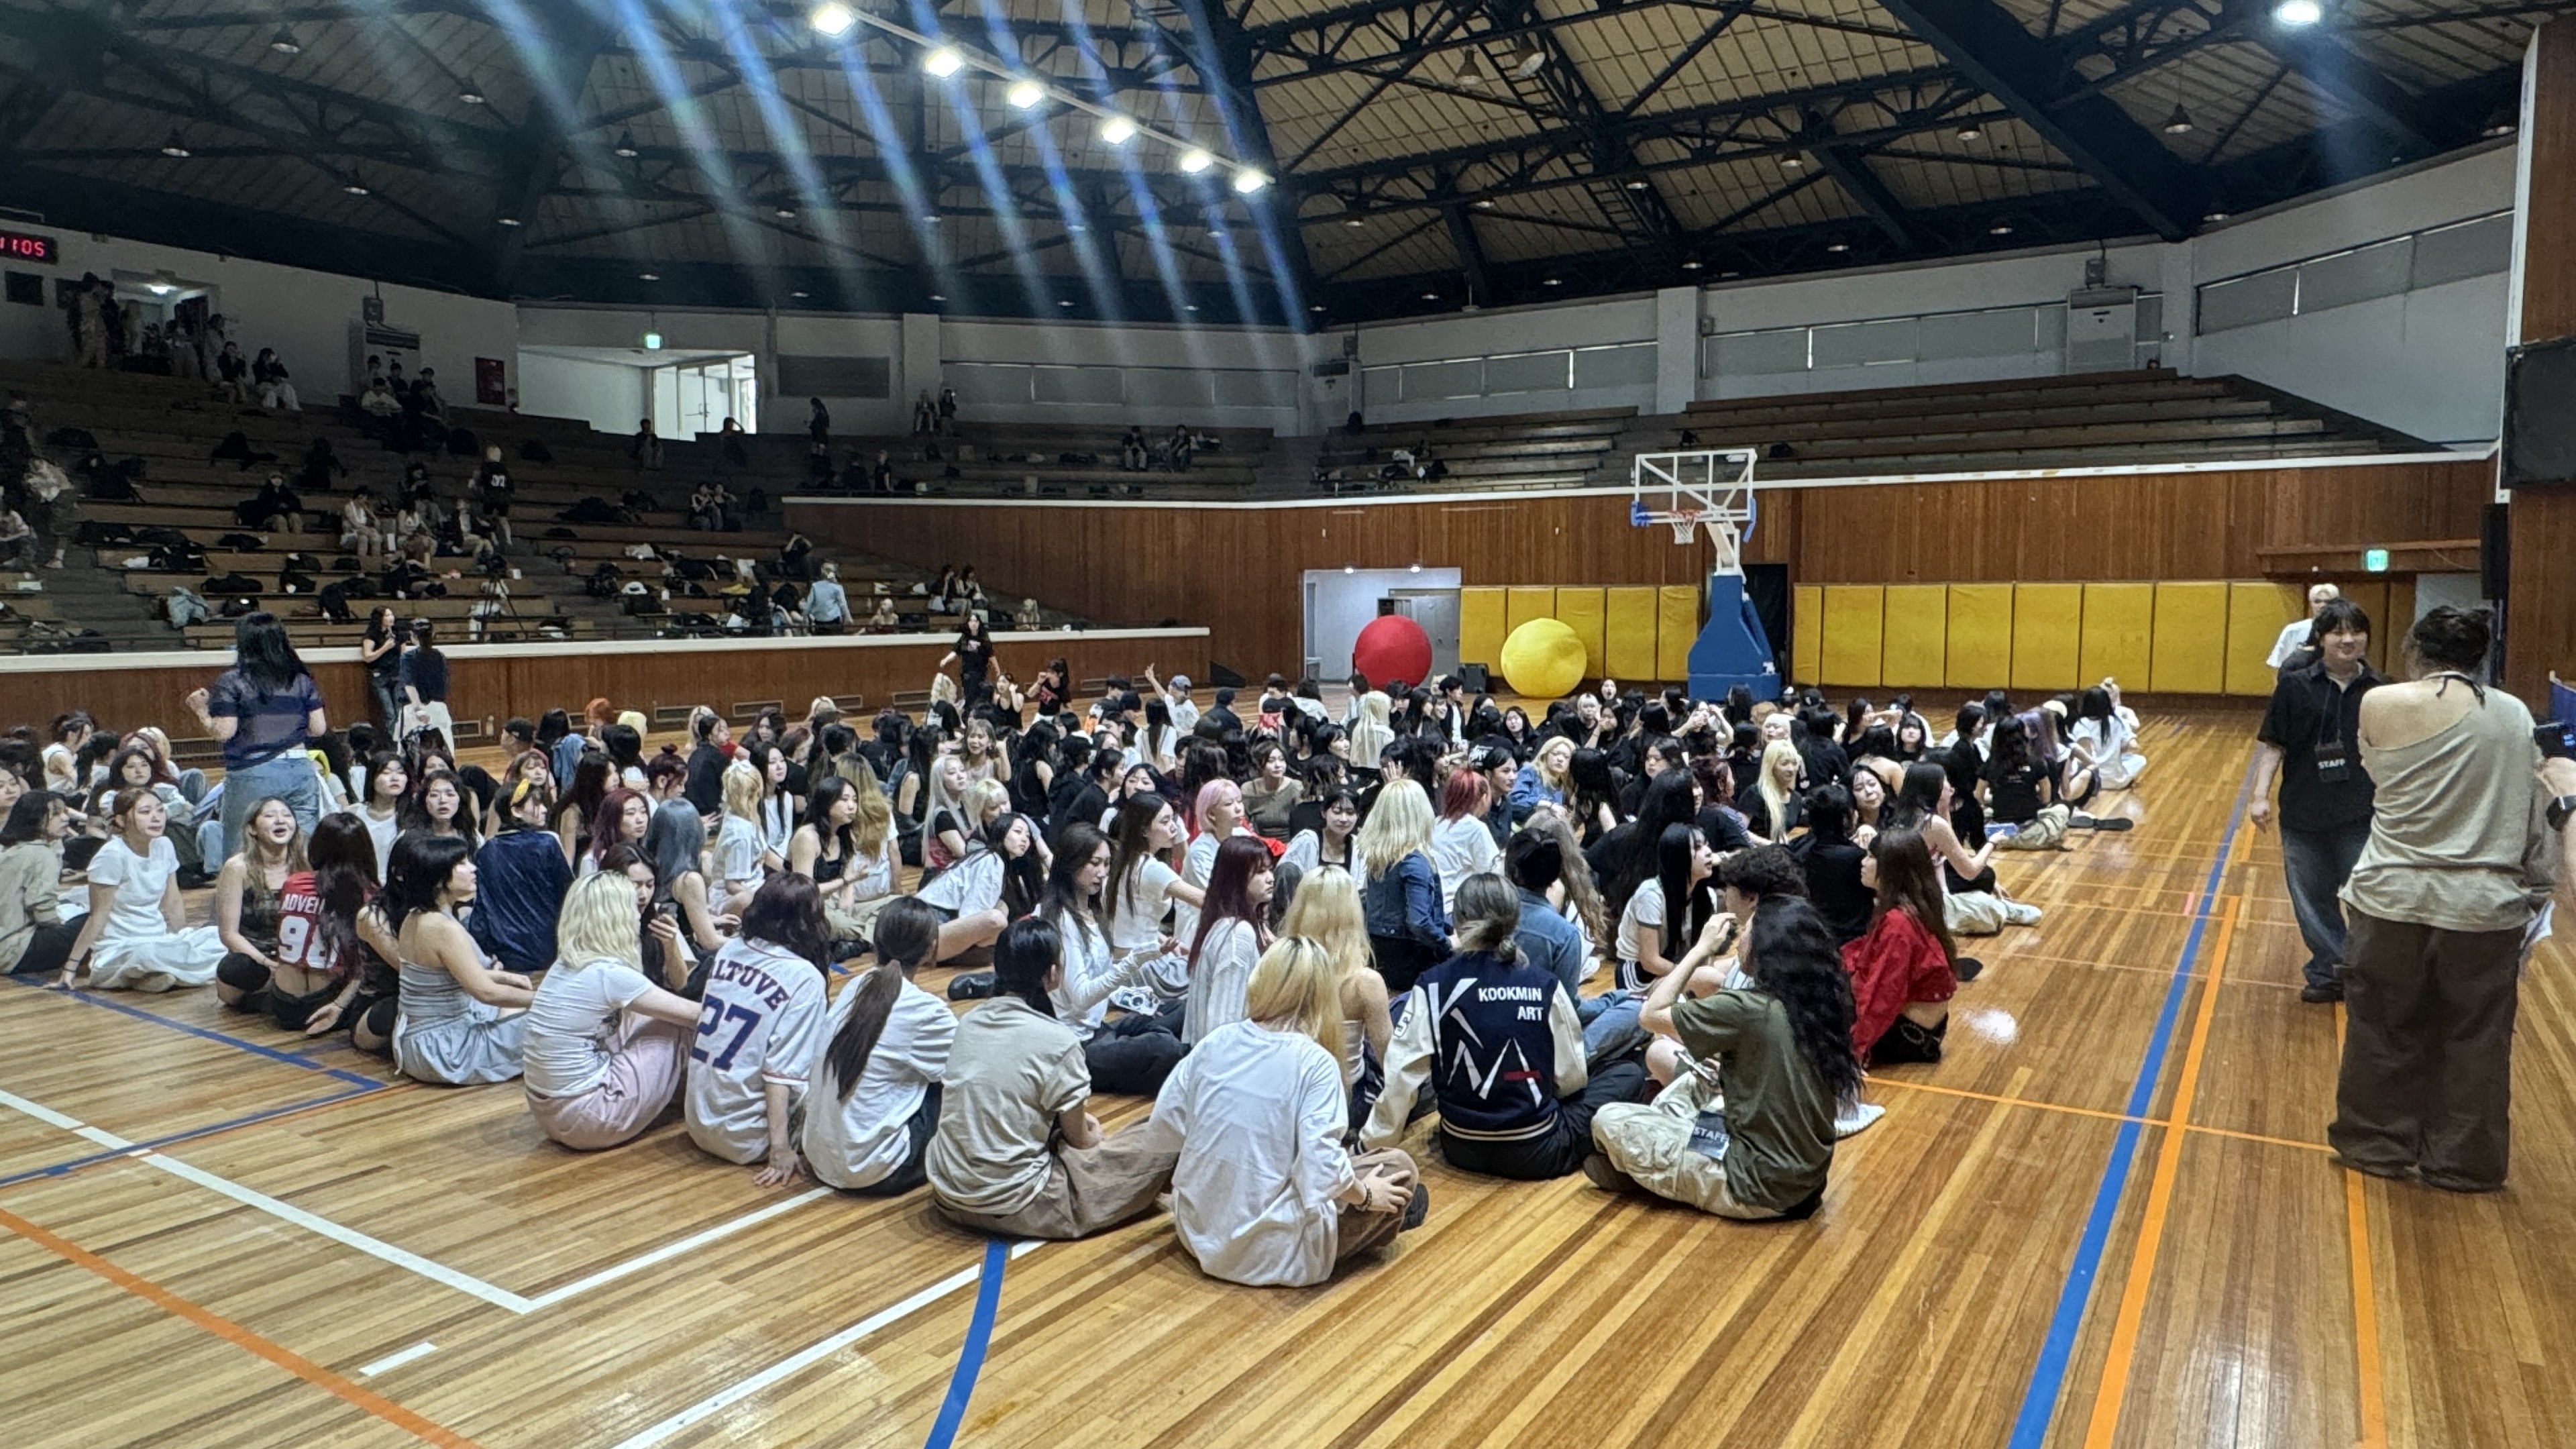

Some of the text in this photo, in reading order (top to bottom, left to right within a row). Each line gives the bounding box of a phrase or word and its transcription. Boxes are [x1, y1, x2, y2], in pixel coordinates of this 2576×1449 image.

[708, 959, 790, 1012] LTUVE
[1478, 986, 1542, 1002] KOOKMIN
[1517, 1006, 1544, 1021] ART
[692, 993, 763, 1072] 27
[1693, 1127, 1729, 1142] STAFF
